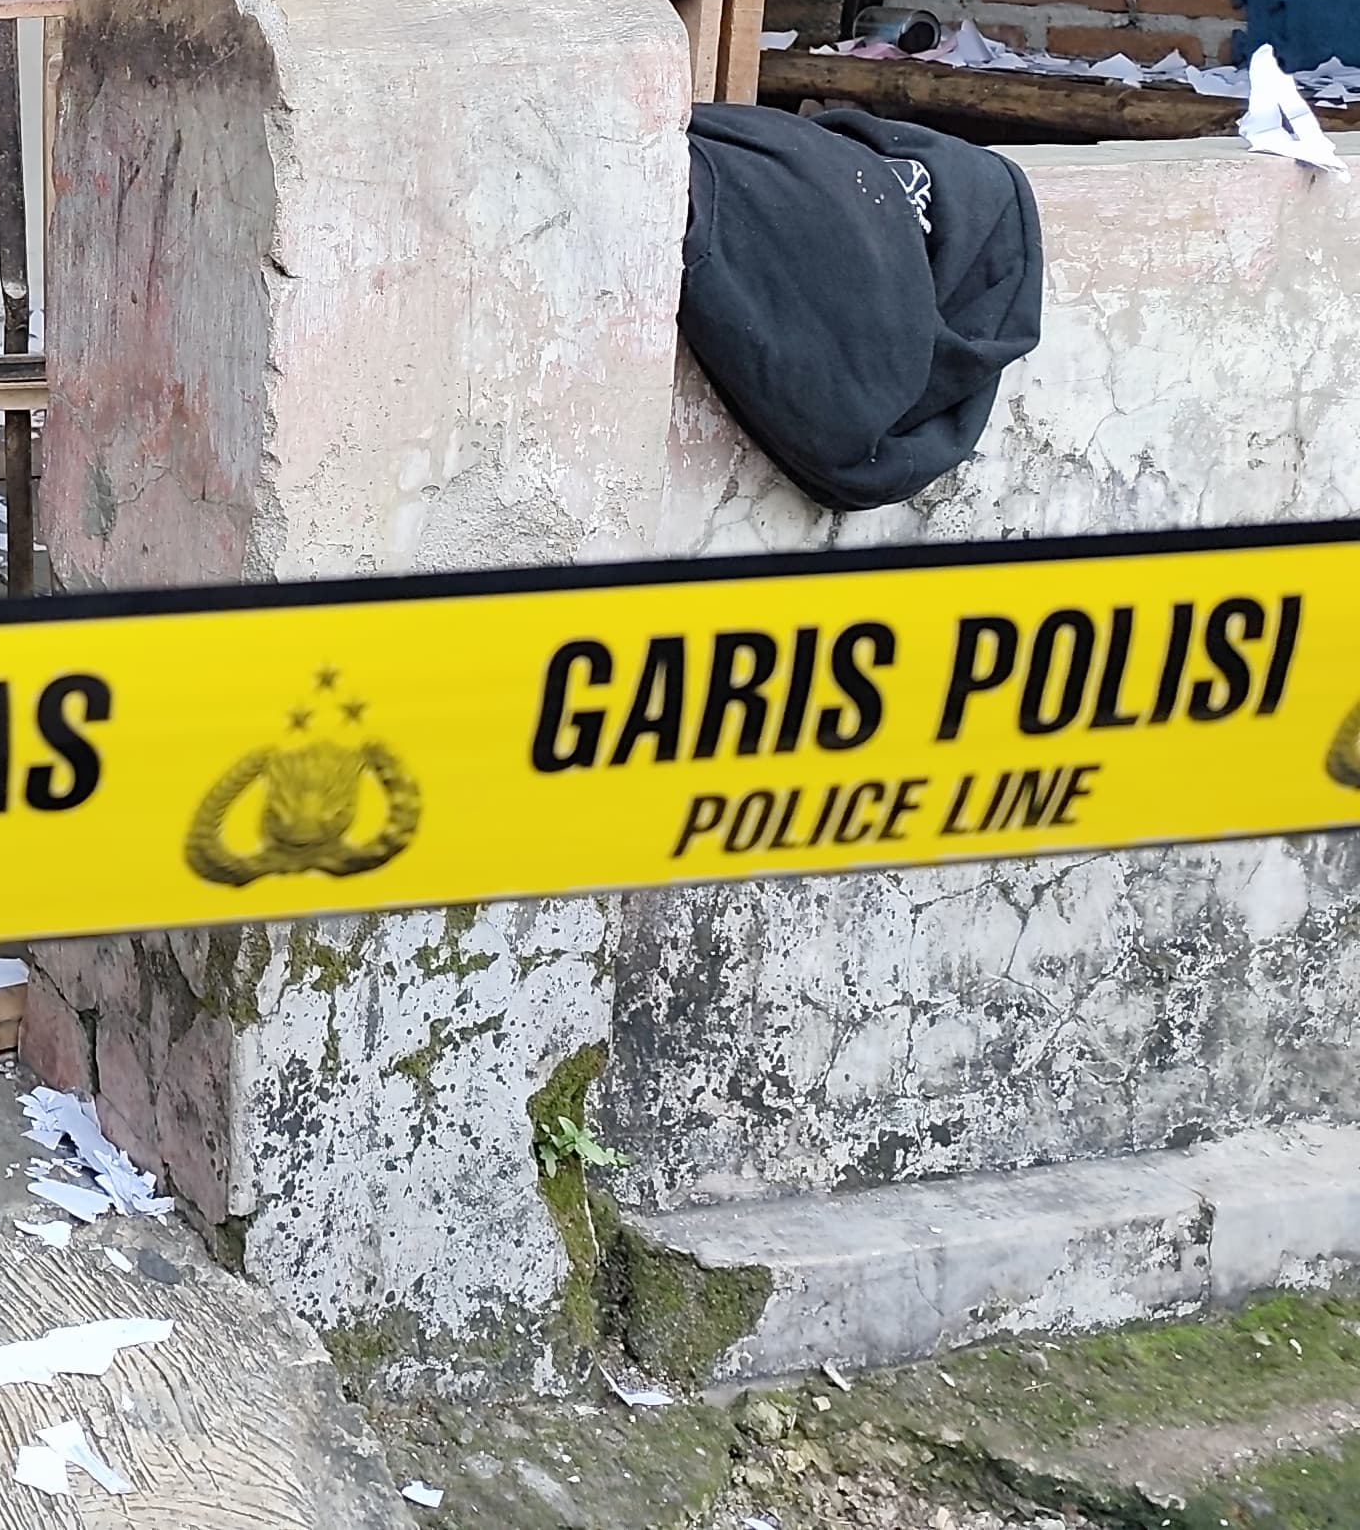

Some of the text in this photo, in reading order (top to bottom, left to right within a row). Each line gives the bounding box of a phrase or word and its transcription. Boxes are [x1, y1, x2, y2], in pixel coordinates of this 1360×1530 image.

[531, 595, 1302, 774] GARIS POLISI
[671, 764, 1102, 860] POLICE LINE
